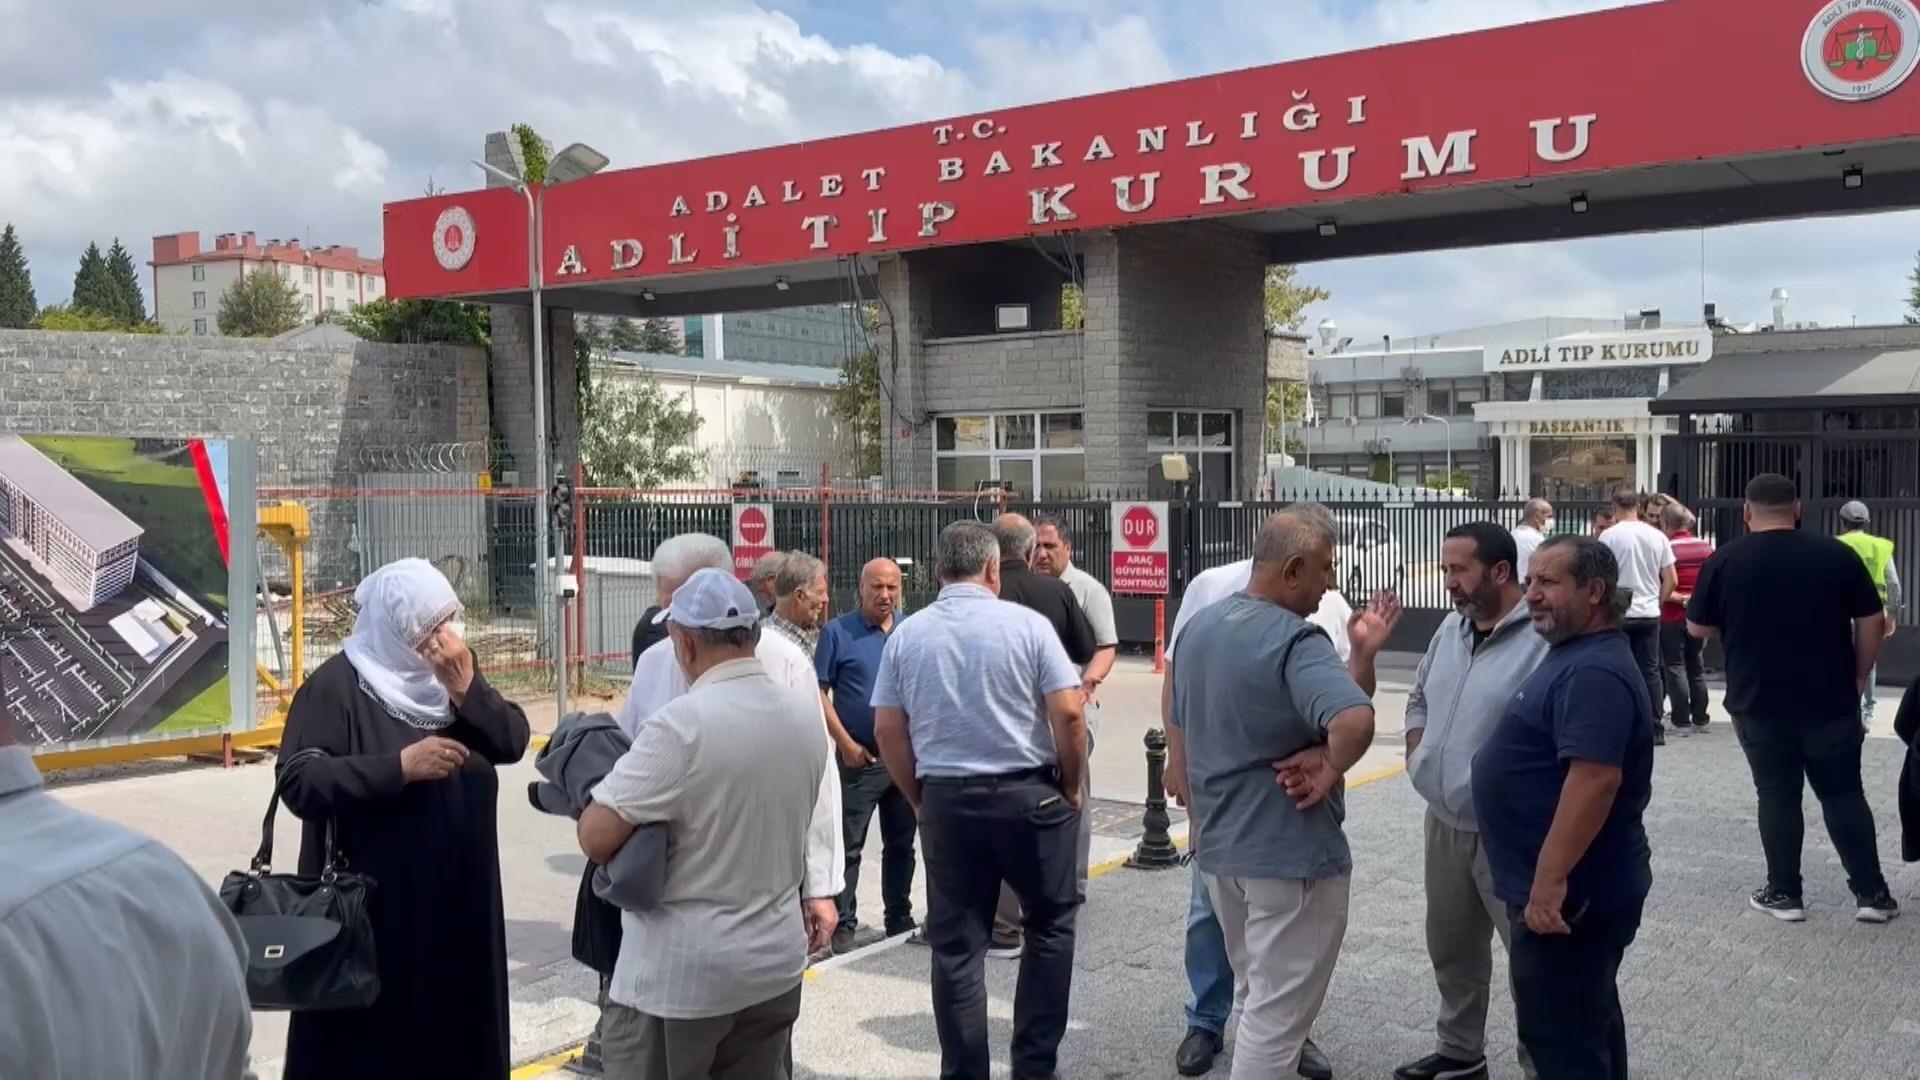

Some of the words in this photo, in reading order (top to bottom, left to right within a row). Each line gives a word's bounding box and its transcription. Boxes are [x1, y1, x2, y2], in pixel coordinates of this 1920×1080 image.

[933, 118, 1006, 145] T.C.
[668, 166, 887, 217] ADALET
[937, 88, 1368, 182] BAKANLIĞI
[556, 212, 742, 275] ADLİ
[801, 200, 956, 250] TIP
[1027, 112, 1598, 225] KURUMU
[1499, 345, 1551, 365] ADLİ
[1558, 345, 1594, 362] TIP
[1601, 340, 1700, 360] KURUMU
[1124, 519, 1155, 536] DUR
[1127, 555, 1154, 566] ARAÇ
[1115, 566, 1166, 577] GÜVENLİK
[1114, 577, 1167, 589] KONTROLÜ
